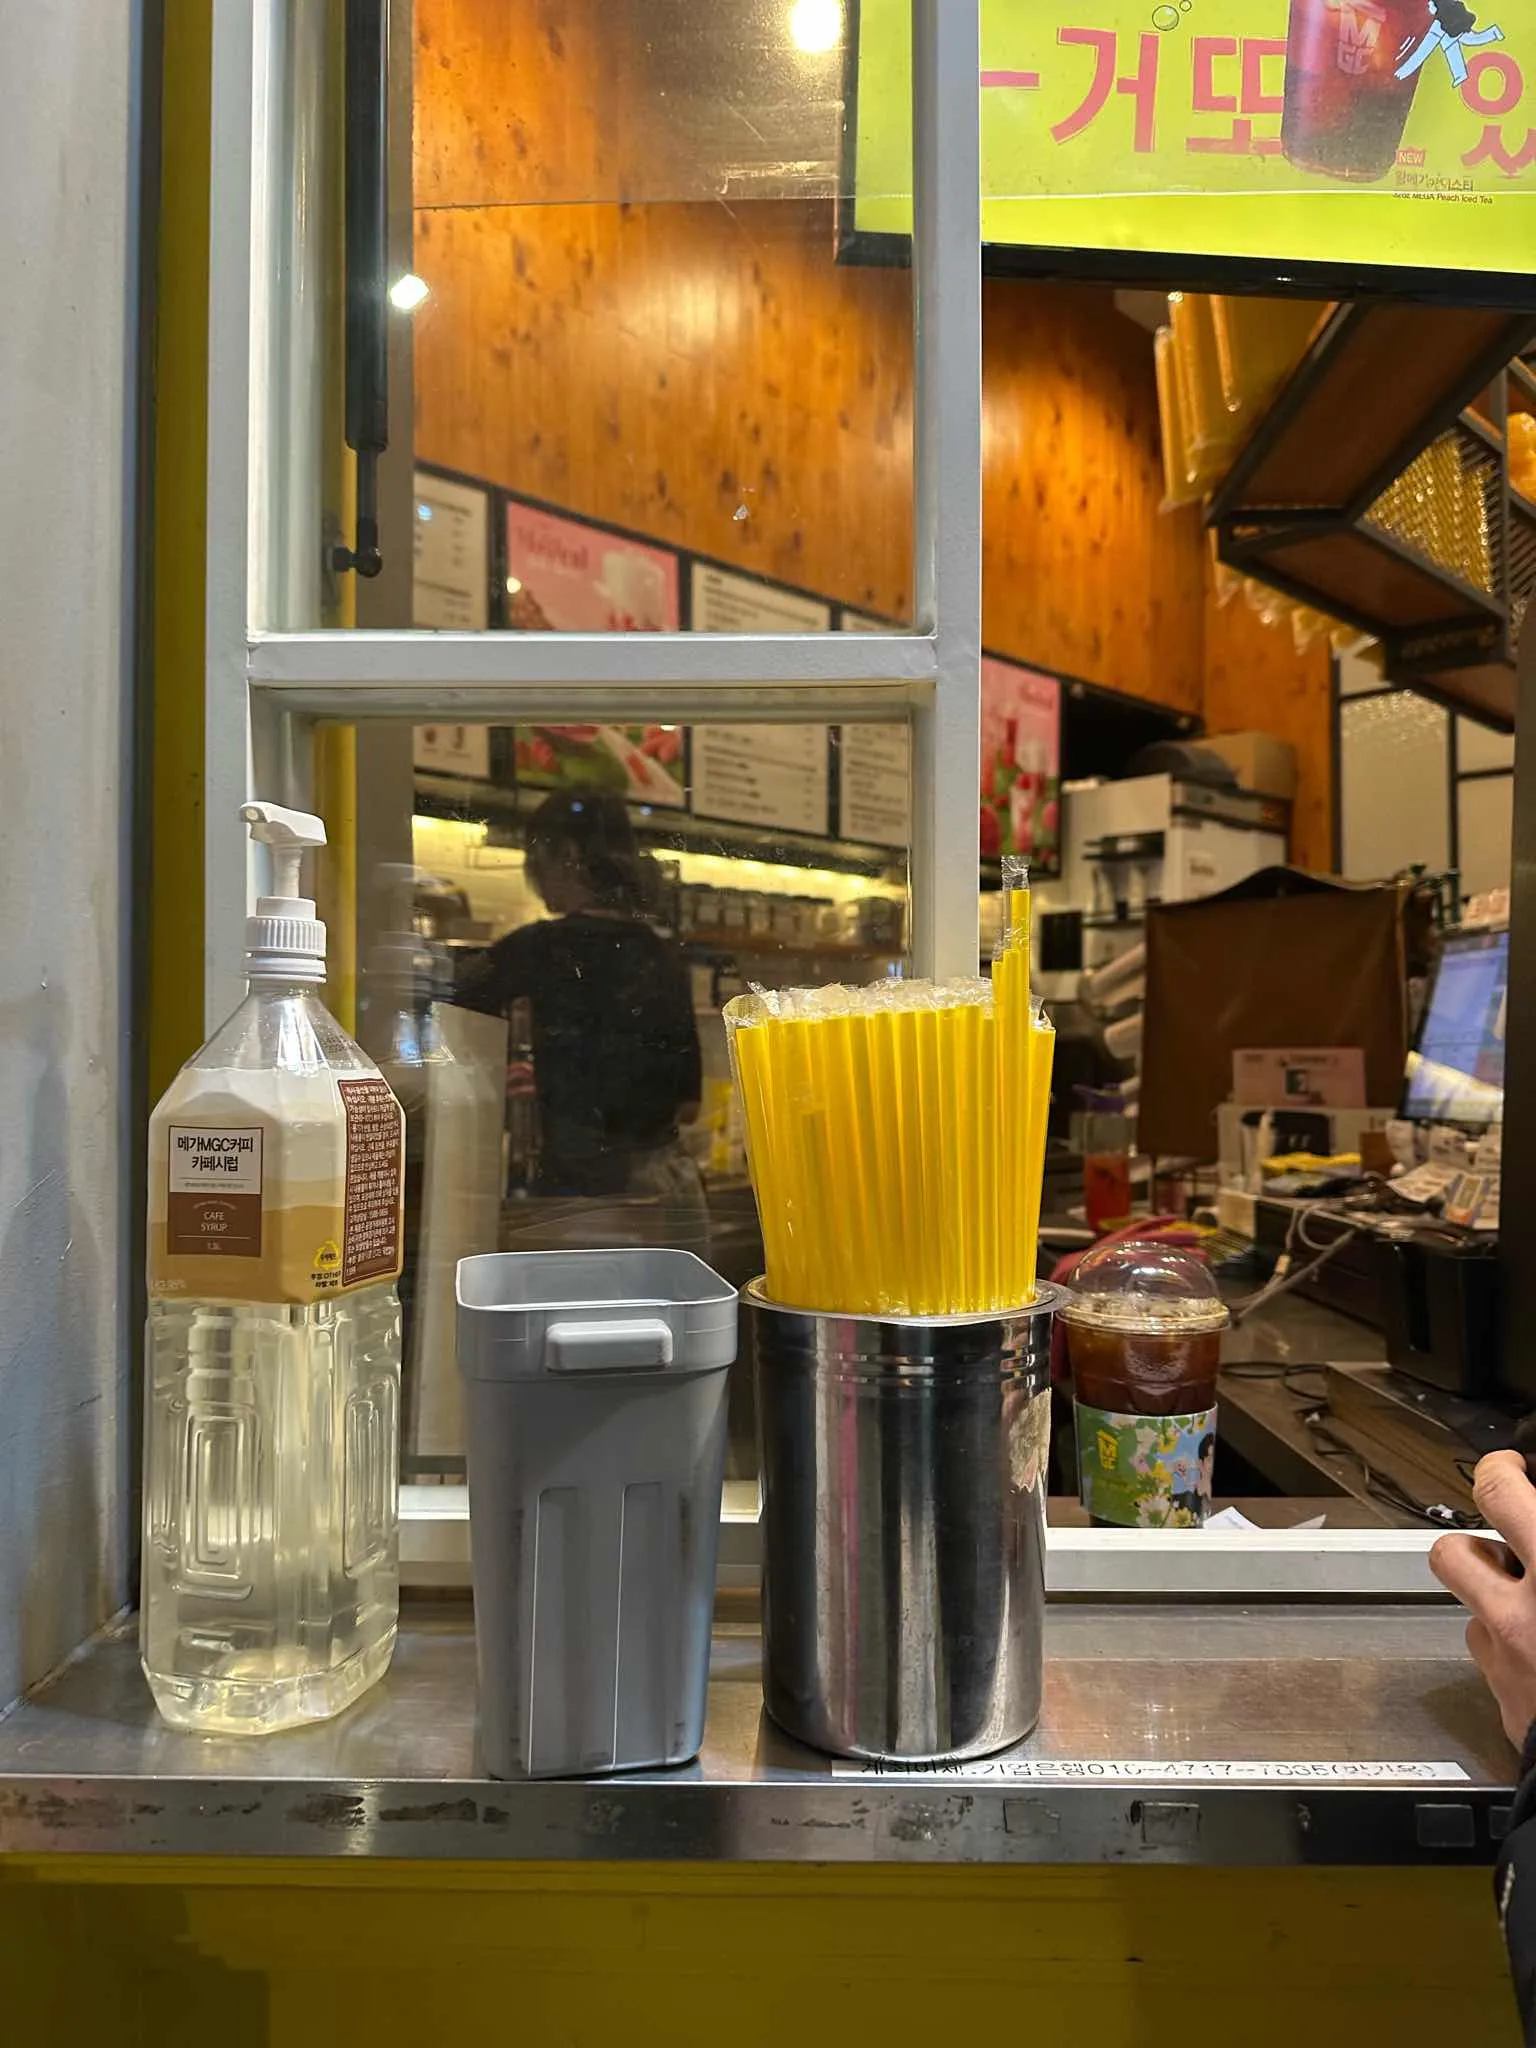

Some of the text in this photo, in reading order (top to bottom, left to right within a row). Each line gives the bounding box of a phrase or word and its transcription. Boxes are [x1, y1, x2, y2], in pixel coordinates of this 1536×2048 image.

[1398, 151, 1423, 164] NEW
[1437, 193, 1460, 203] Peach
[1461, 194, 1478, 204] Iced
[1480, 195, 1494, 205] Tea
[176, 1135, 254, 1154] 메가MGC커피
[191, 1155, 239, 1173] 카페시럽
[203, 1211, 225, 1222] CAFE
[200, 1222, 228, 1233] SYRUP
